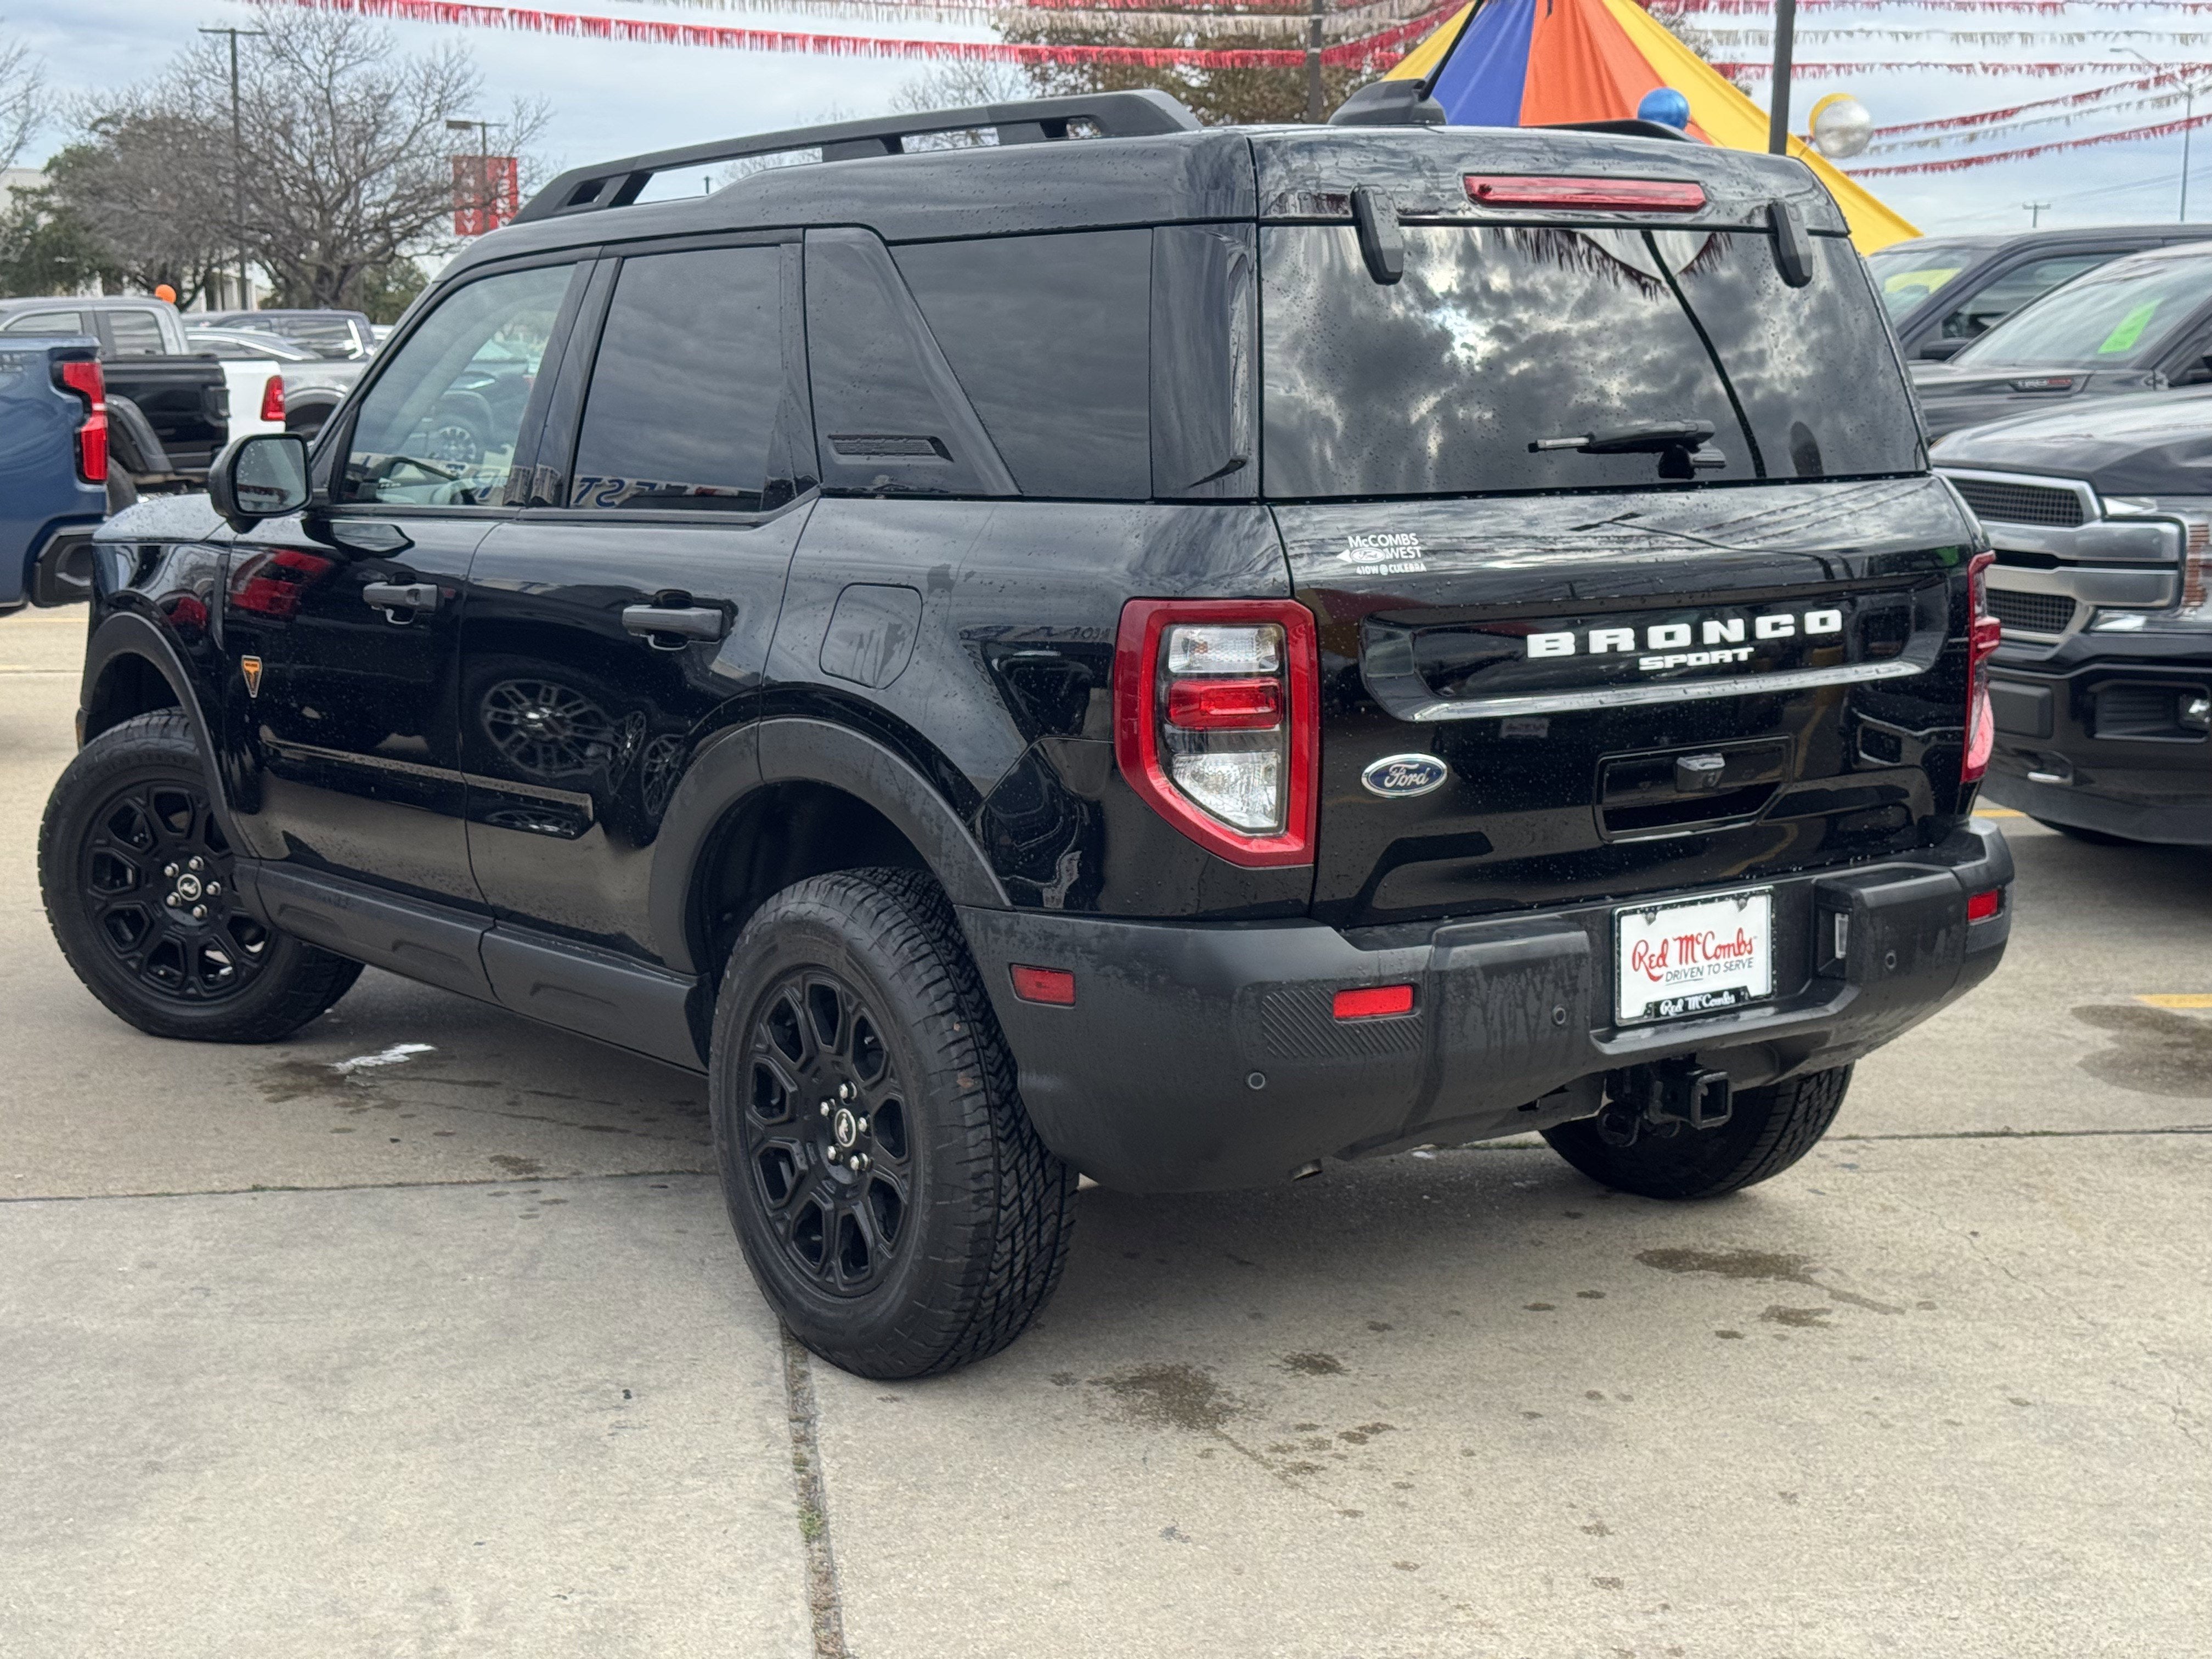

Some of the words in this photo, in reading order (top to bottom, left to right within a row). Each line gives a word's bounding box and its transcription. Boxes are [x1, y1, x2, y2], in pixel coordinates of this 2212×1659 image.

[1347, 533, 1419, 548] McCOMBS
[1383, 546, 1422, 560] WEST
[1527, 609, 1842, 658] BRONCO
[1639, 647, 1754, 671] SPORT
[1384, 763, 1431, 788] Ford
[1632, 938, 1668, 982] Red
[1672, 927, 1753, 965] McCombs
[1666, 965, 1704, 982] DRIVEN
[1707, 963, 1720, 975] TO
[1723, 957, 1754, 973] SERVE
[1660, 998, 1684, 1016] Red
[1685, 991, 1736, 1010] McCombs
